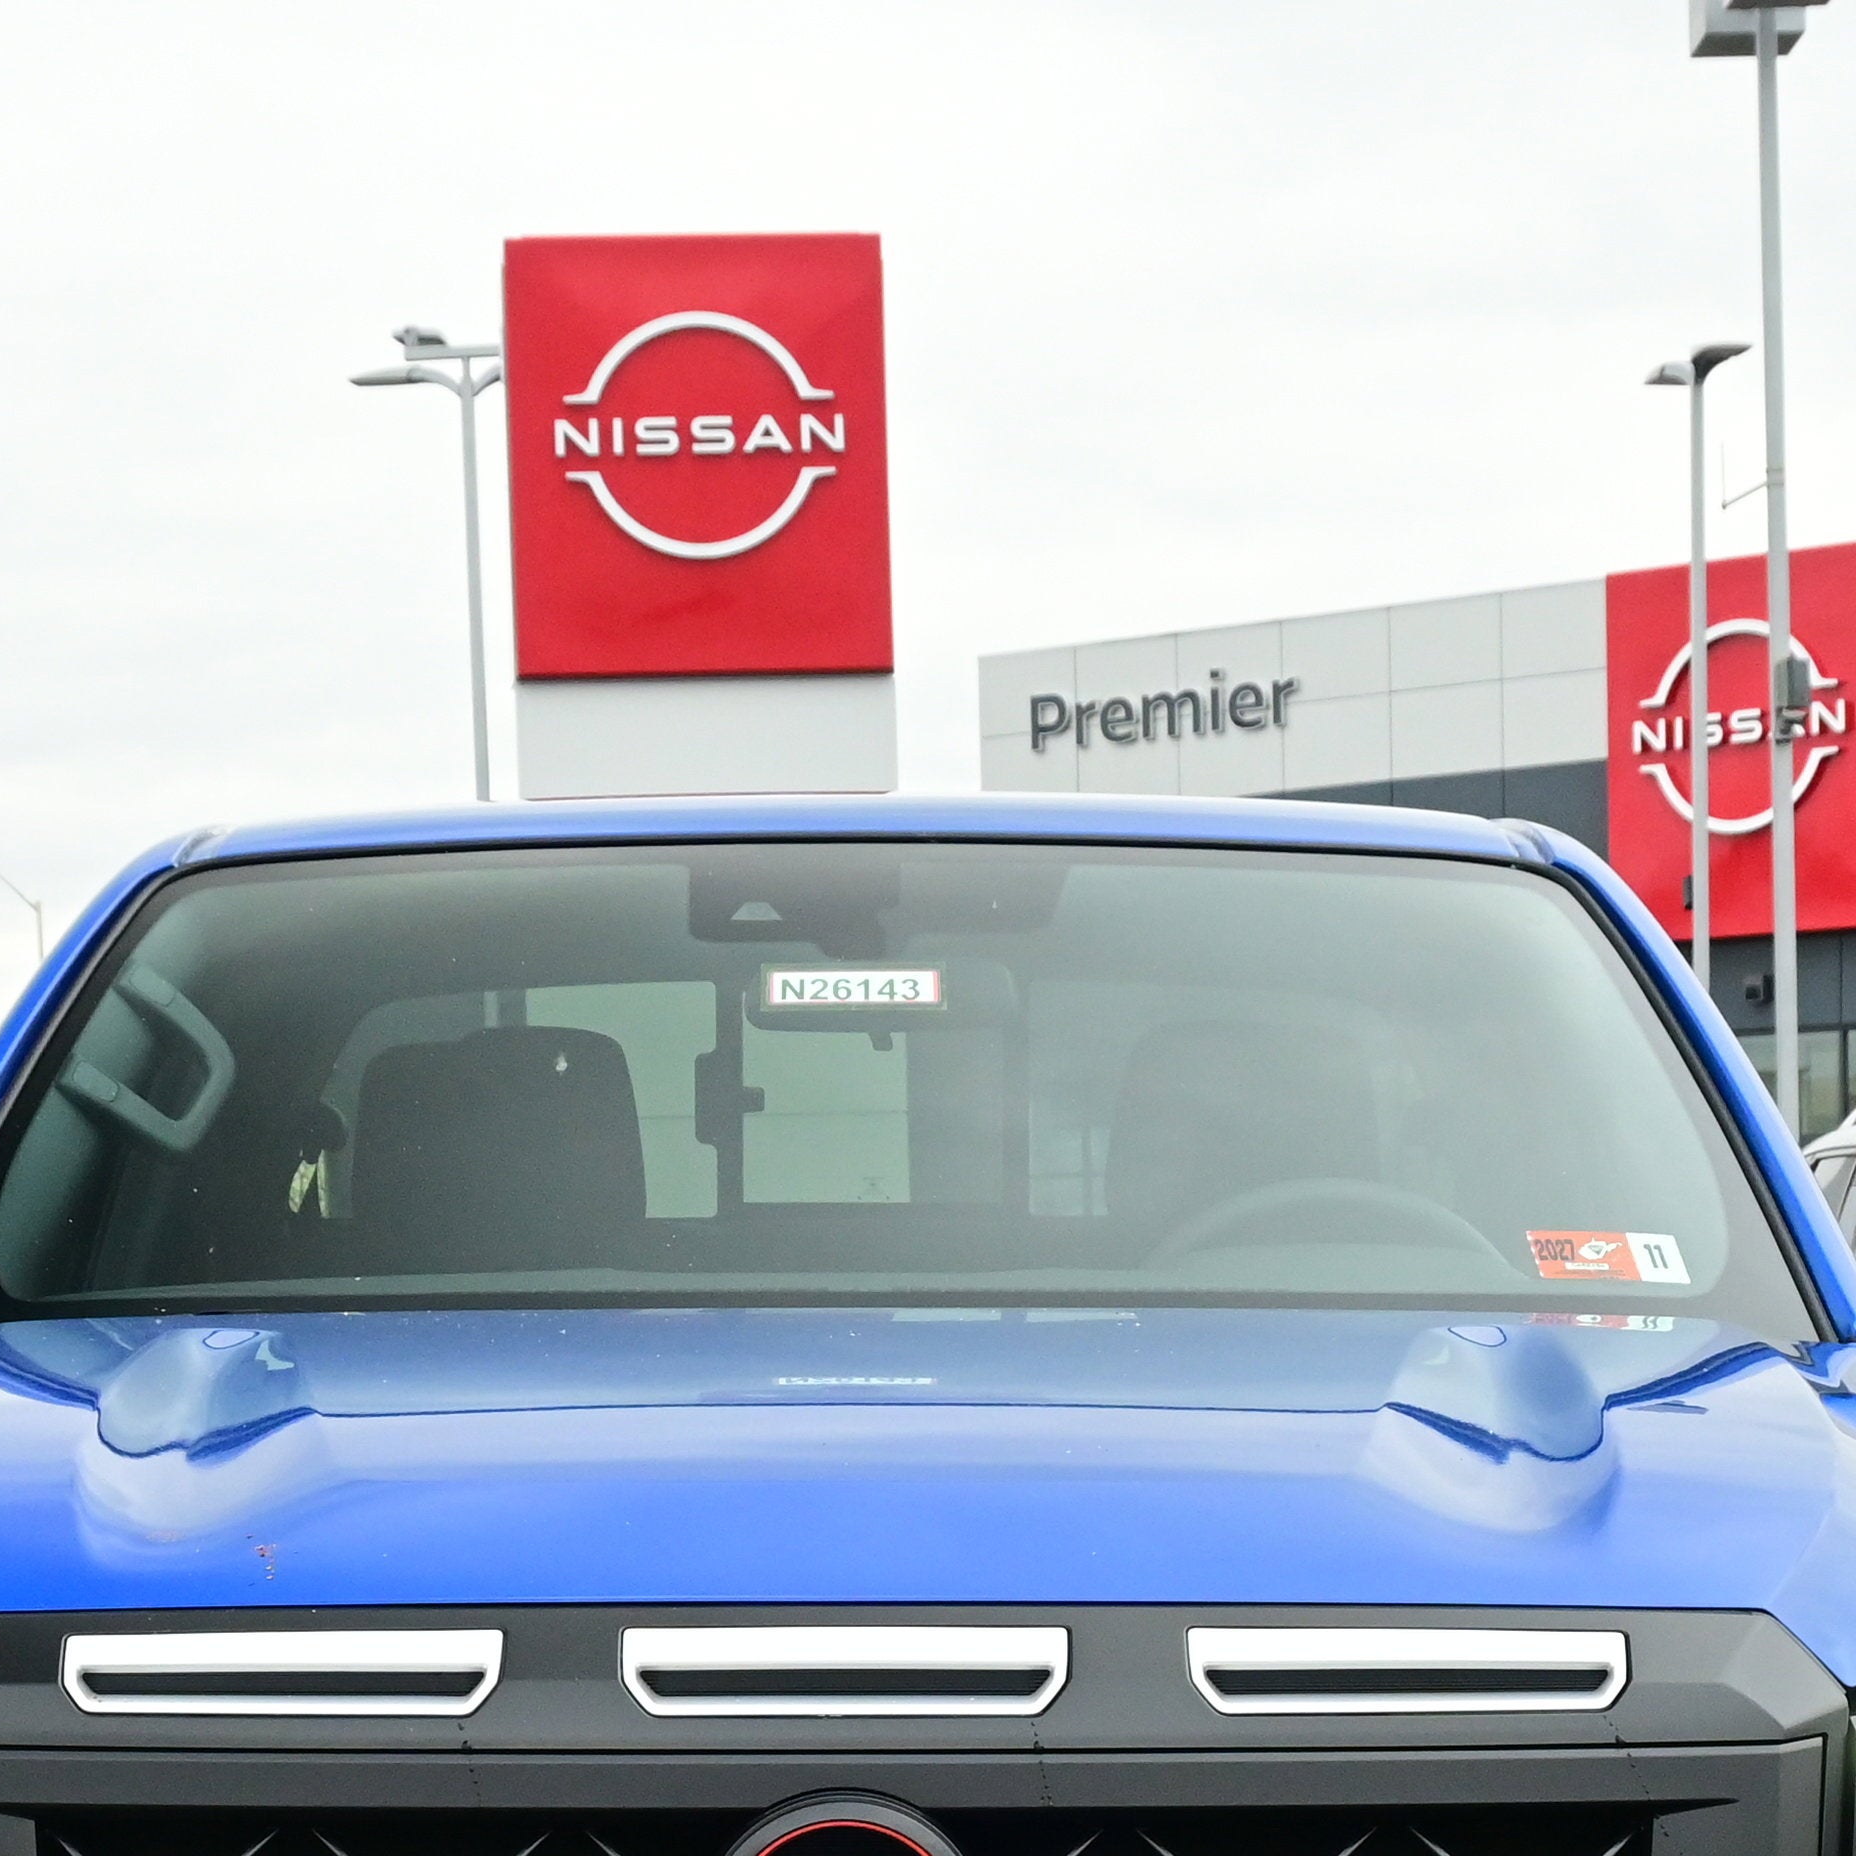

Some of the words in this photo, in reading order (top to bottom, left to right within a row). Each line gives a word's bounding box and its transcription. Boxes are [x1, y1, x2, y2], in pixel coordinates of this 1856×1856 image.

[553, 413, 846, 457] NISSAN
[1030, 667, 1300, 751] Premier
[780, 978, 921, 1001] N26143
[1534, 1238, 1575, 1261] 2027
[1643, 1243, 1669, 1269] 11
